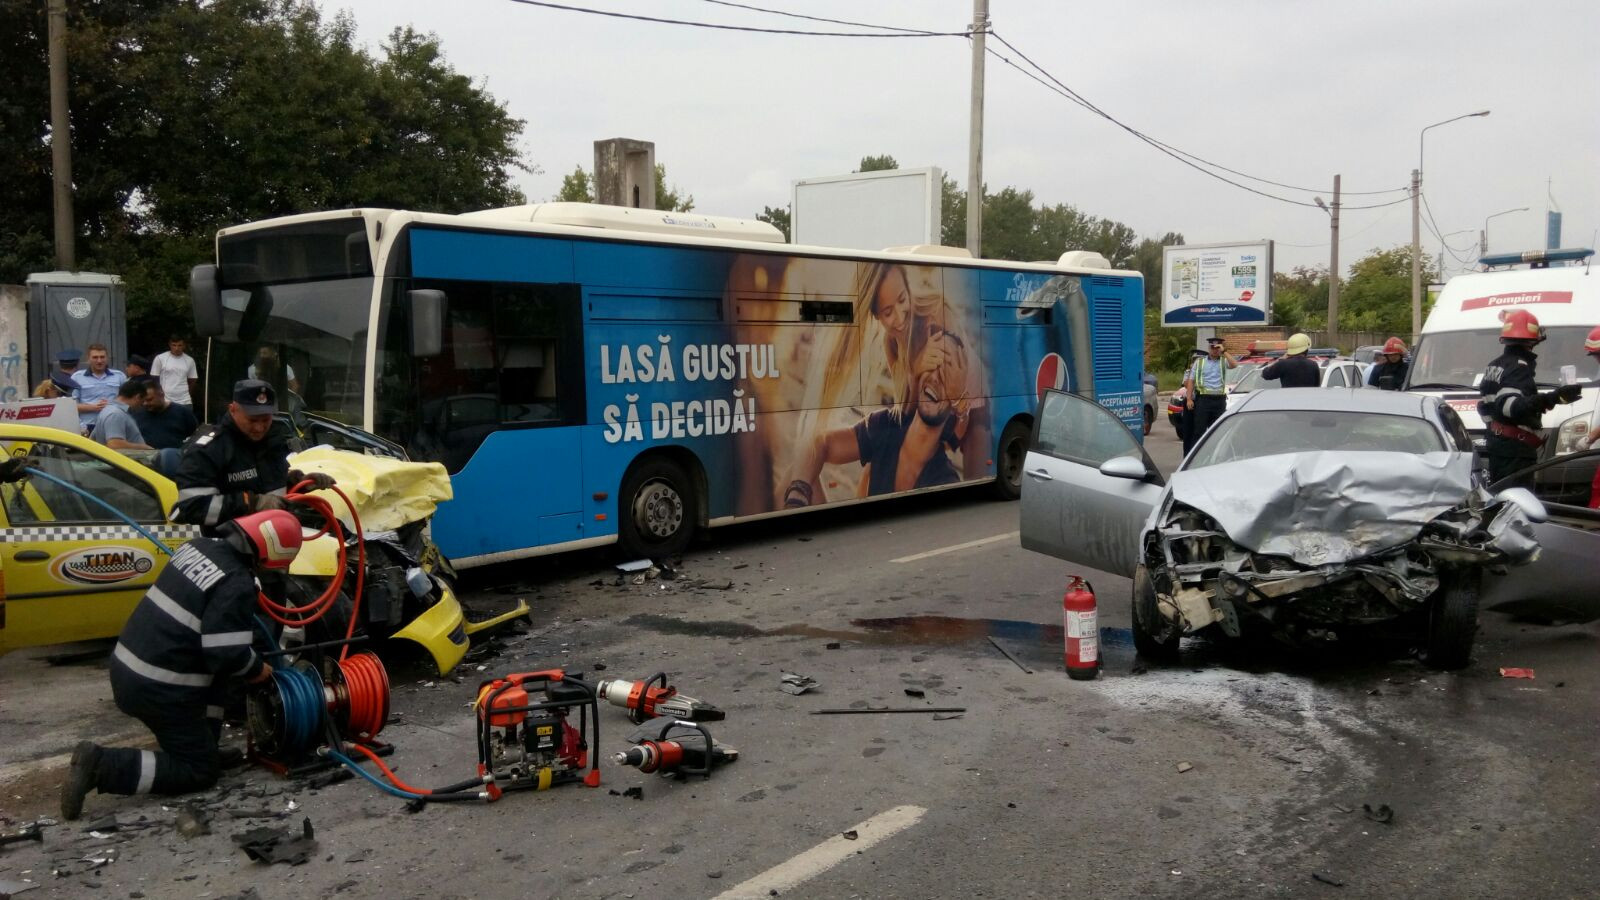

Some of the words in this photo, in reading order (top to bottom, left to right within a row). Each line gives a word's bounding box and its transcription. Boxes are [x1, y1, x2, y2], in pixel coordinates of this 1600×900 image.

[1487, 293, 1542, 306] Pompieri
[600, 334, 675, 384] LASĂ
[682, 344, 780, 381] GUSTUL
[603, 393, 644, 443] SĂ
[651, 388, 756, 439] DECIDĂ!
[83, 551, 135, 567] TITAN
